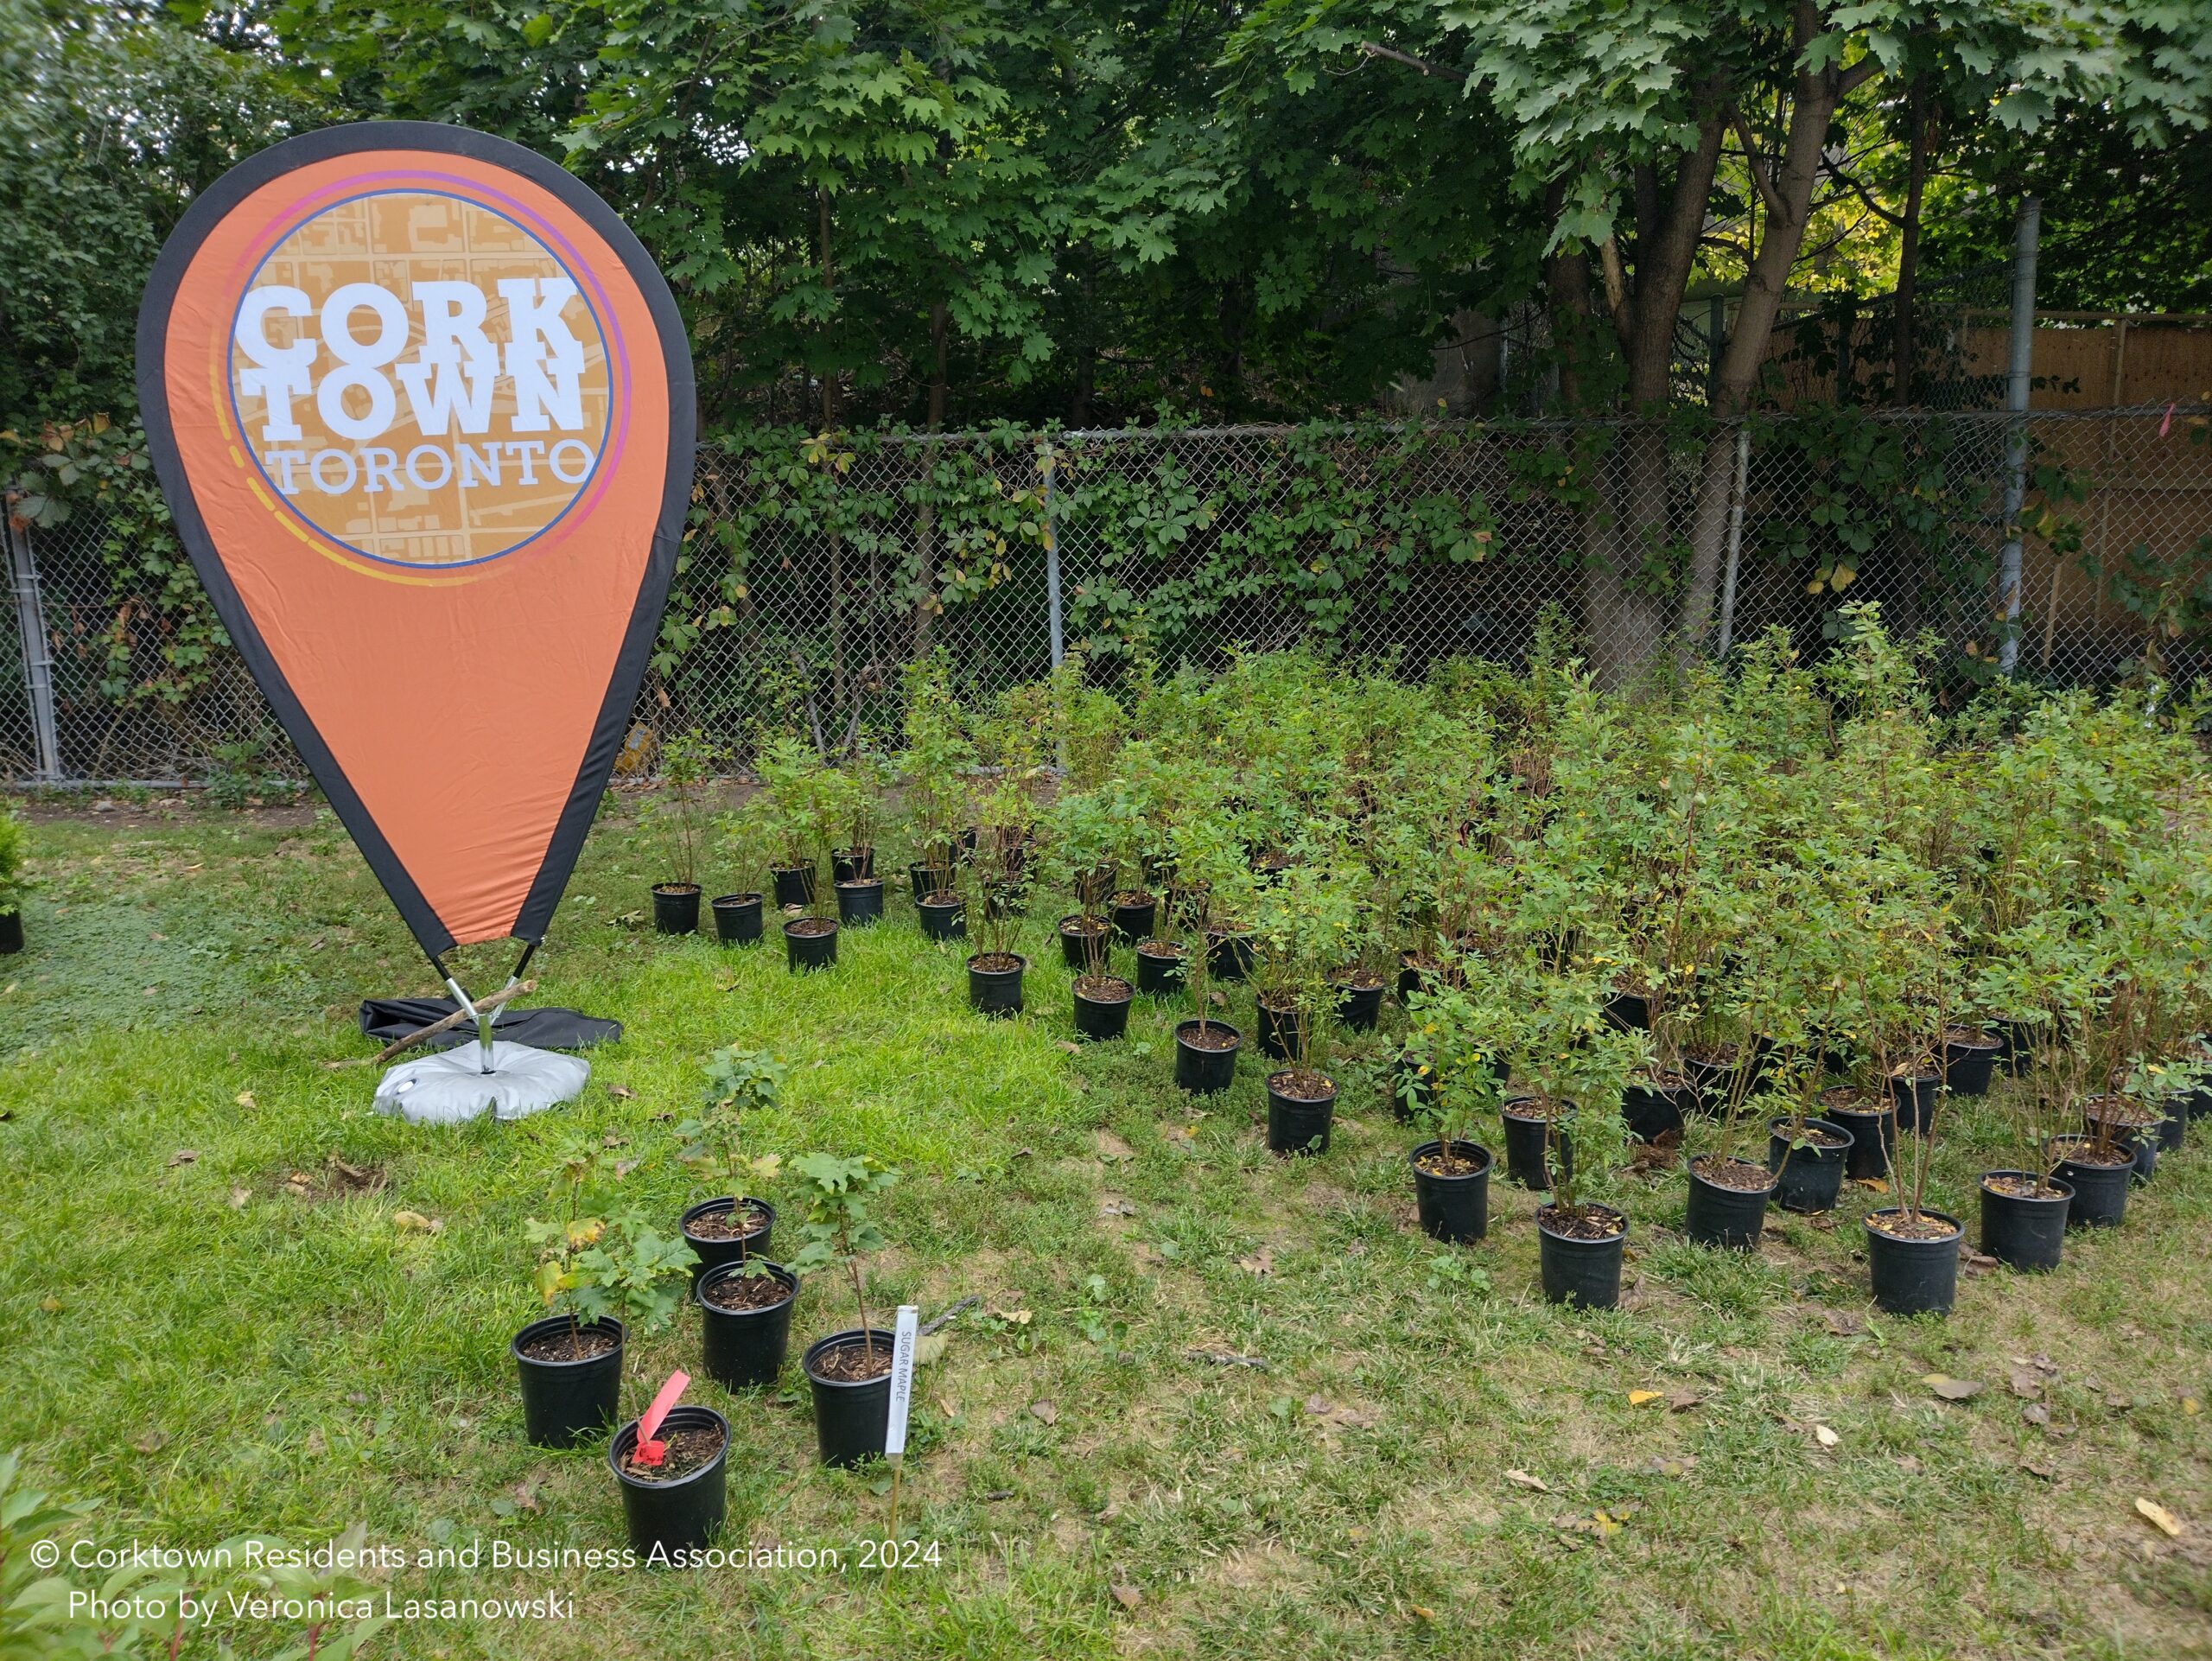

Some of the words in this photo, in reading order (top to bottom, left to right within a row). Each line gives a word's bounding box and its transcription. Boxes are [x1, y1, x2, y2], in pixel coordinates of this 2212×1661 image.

[234, 277, 584, 369] CORK
[239, 352, 586, 442] TOWN
[264, 438, 595, 496] TORONTO
[899, 1331, 912, 1366] SUGAR
[895, 1368, 908, 1403] MAPLE
